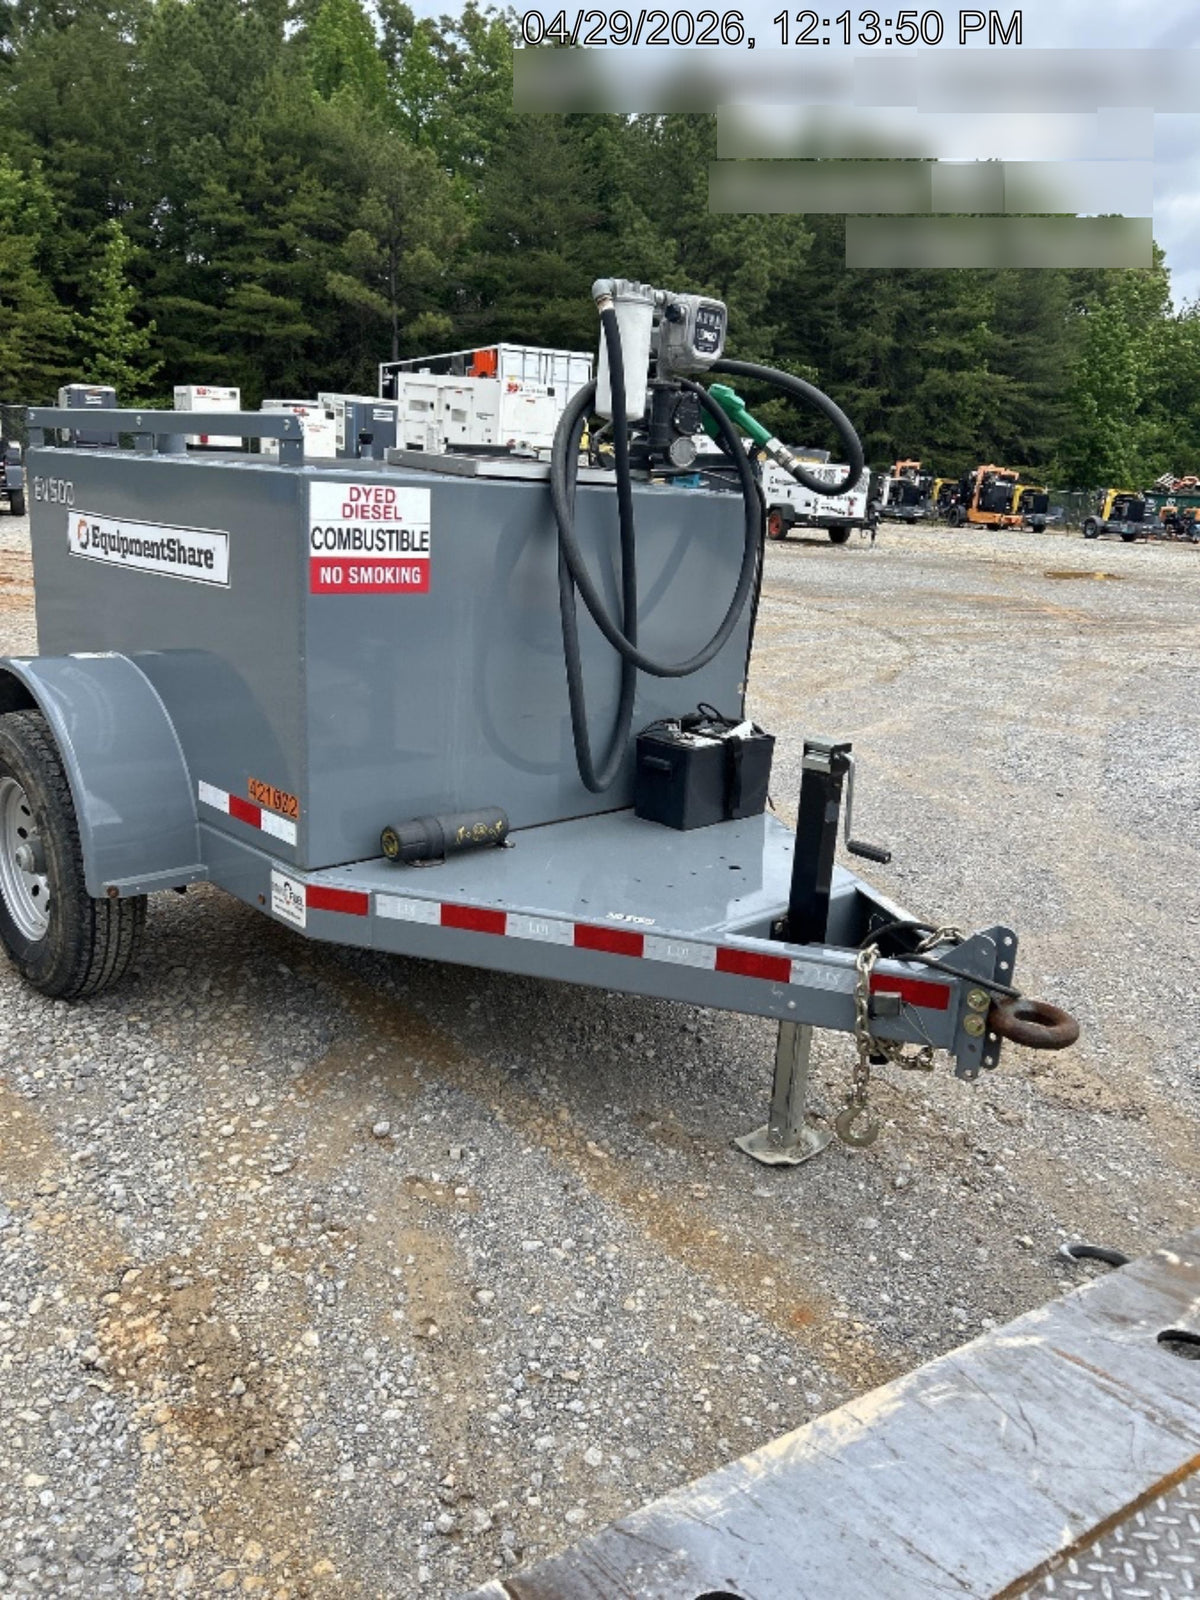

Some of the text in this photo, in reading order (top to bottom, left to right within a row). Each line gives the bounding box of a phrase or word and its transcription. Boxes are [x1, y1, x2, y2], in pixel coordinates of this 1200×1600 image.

[349, 486, 396, 504] DYED
[342, 503, 402, 520] DIESEL
[91, 524, 214, 570] EquipmentShare
[311, 526, 429, 552] COMBUSTIBLE
[320, 566, 421, 584] NO SMOKING
